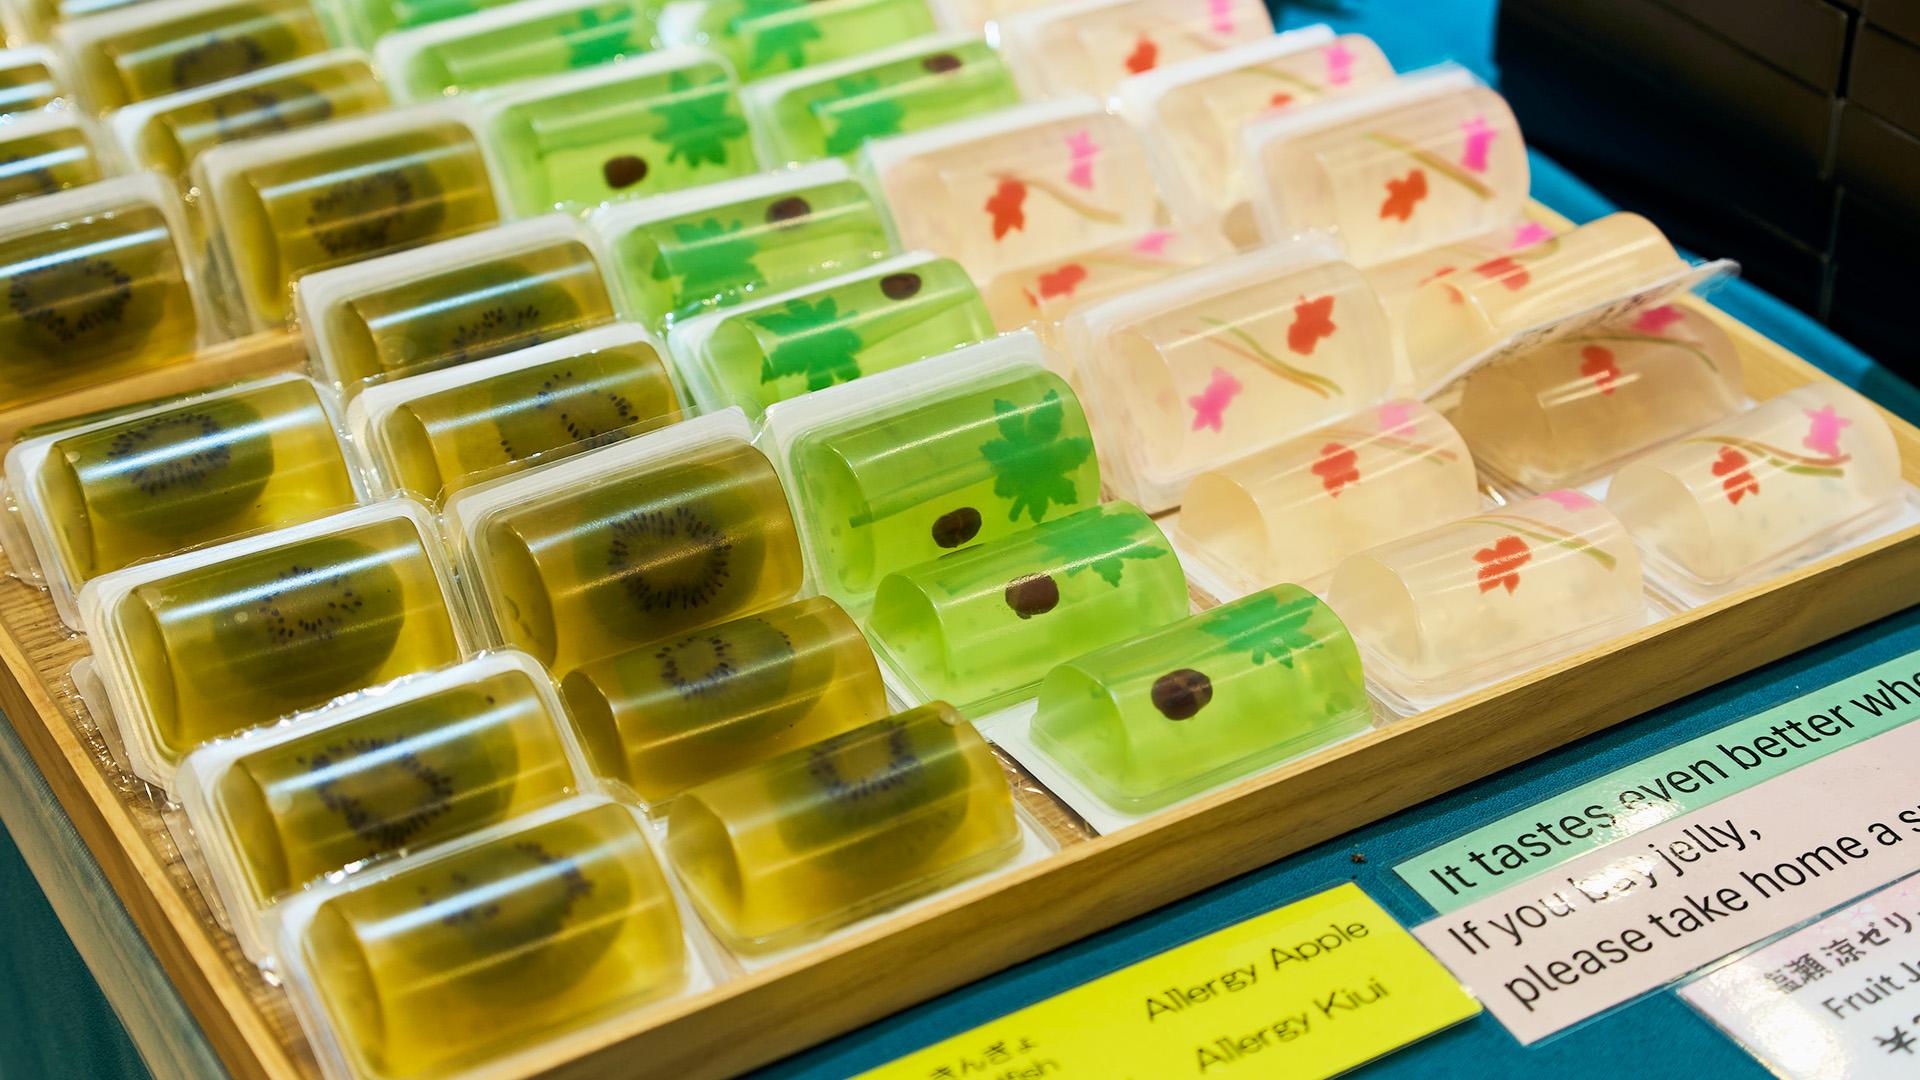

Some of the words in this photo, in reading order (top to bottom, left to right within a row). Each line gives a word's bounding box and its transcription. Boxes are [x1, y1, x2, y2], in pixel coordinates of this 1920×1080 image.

[1429, 865, 1477, 895] It
[1468, 804, 1616, 876] tastes
[1619, 757, 1729, 810] even
[1717, 705, 1855, 770] better
[1448, 921, 1490, 955] If
[1488, 892, 1576, 946] you
[1504, 929, 1653, 1012] please
[1648, 887, 1748, 938] take
[1739, 835, 1868, 898] home
[1867, 823, 1903, 846] a
[1146, 964, 1257, 1021] Allergy
[1270, 922, 1369, 970] Apple
[1821, 975, 1905, 1019] Fruit
[1197, 1012, 1310, 1073] Allergy
